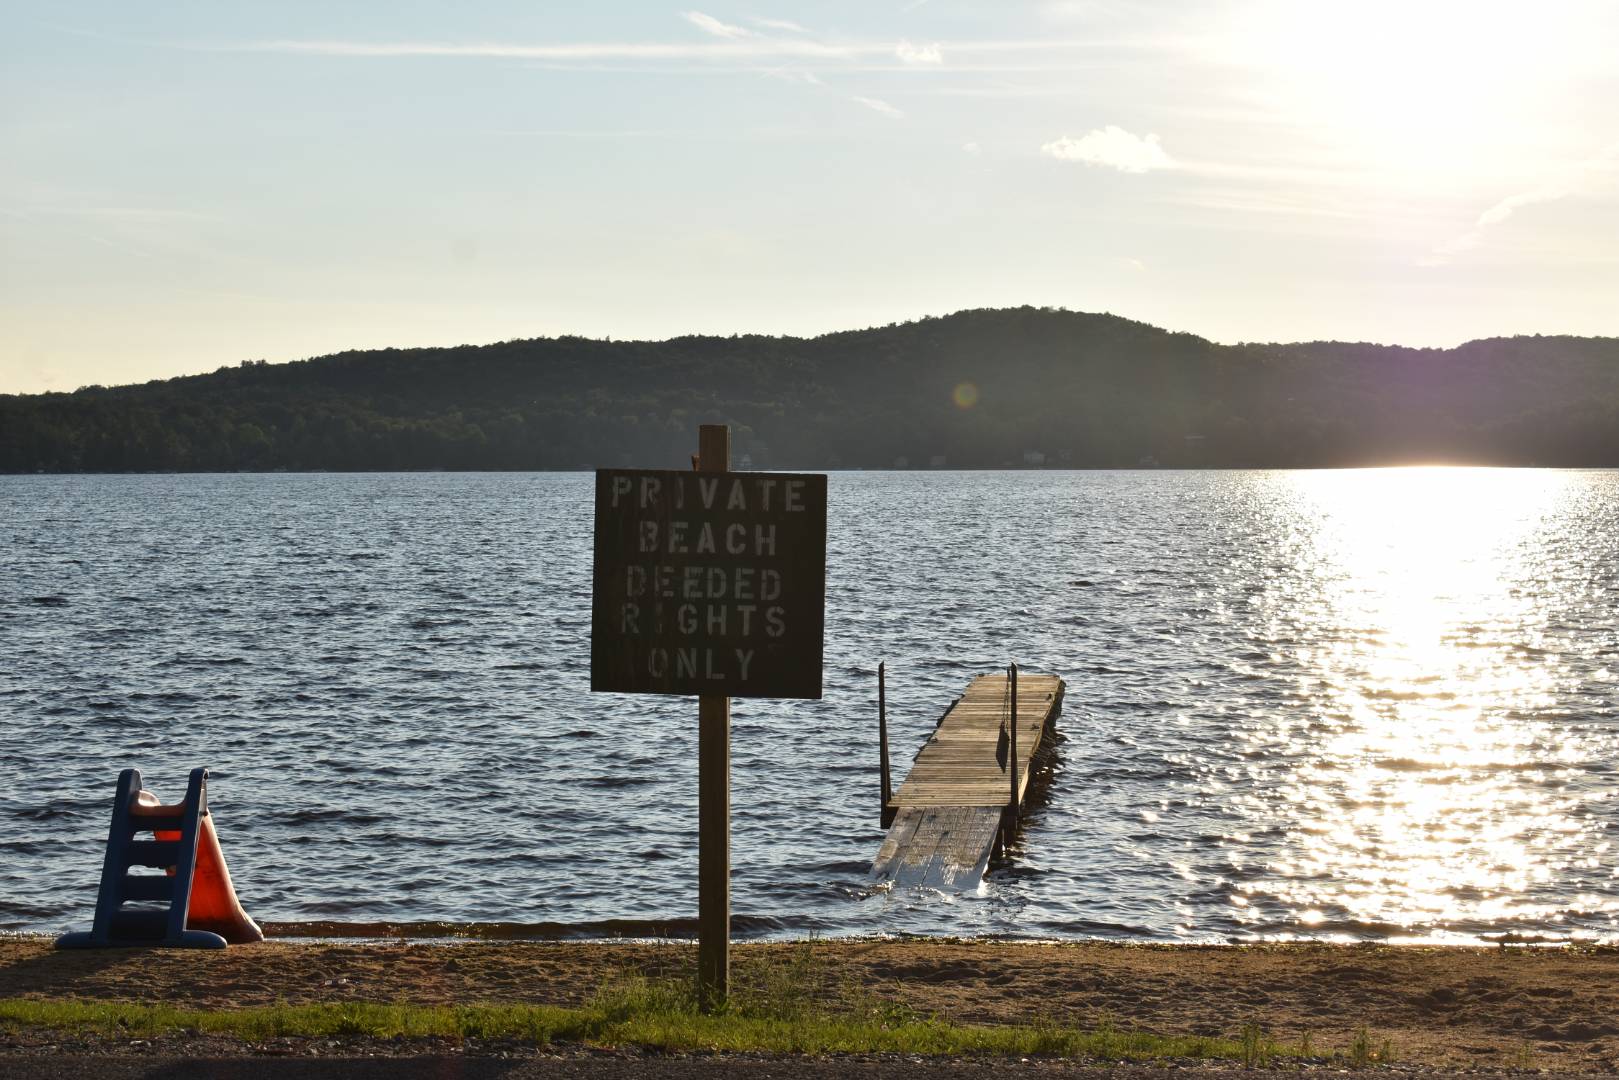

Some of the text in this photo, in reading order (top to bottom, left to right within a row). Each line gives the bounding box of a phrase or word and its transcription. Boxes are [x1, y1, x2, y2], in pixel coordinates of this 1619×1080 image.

[611, 476, 806, 511] PRIVATE
[639, 521, 776, 556] BEACH
[626, 565, 782, 601] DEEDED
[648, 648, 754, 680] ONLY
